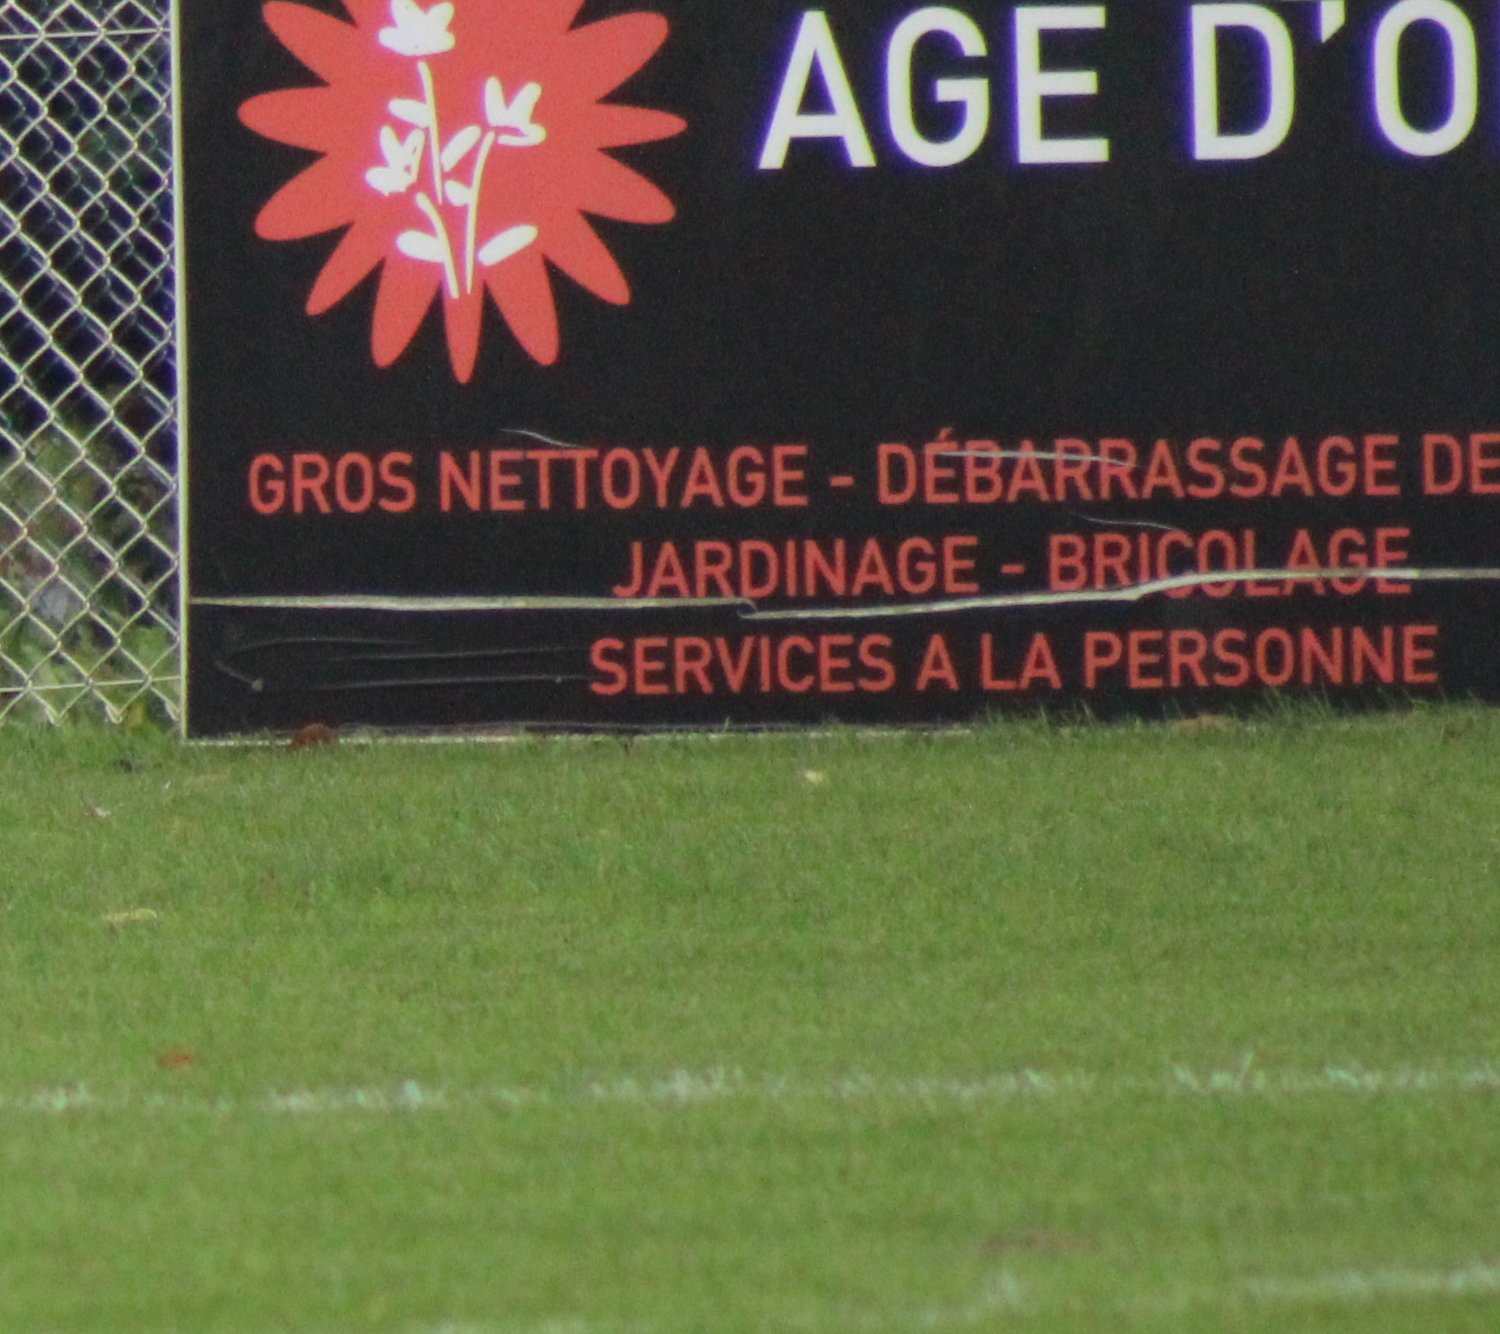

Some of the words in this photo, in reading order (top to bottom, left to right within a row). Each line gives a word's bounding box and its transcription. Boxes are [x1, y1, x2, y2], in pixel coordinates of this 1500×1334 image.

[758, 6, 1109, 170] AGE
[248, 451, 417, 514] GROS
[439, 445, 808, 512] NETTOYAGE
[877, 427, 1400, 505] DÉBARRASSAGE
[1422, 432, 1500, 495] DE
[613, 535, 979, 600] JARDINAGE
[1049, 527, 1412, 599] BRICOLAGE
[590, 634, 896, 696] SERVICES
[916, 634, 959, 690] A
[980, 632, 1062, 690] LA
[1084, 624, 1439, 689] PERSONNE
